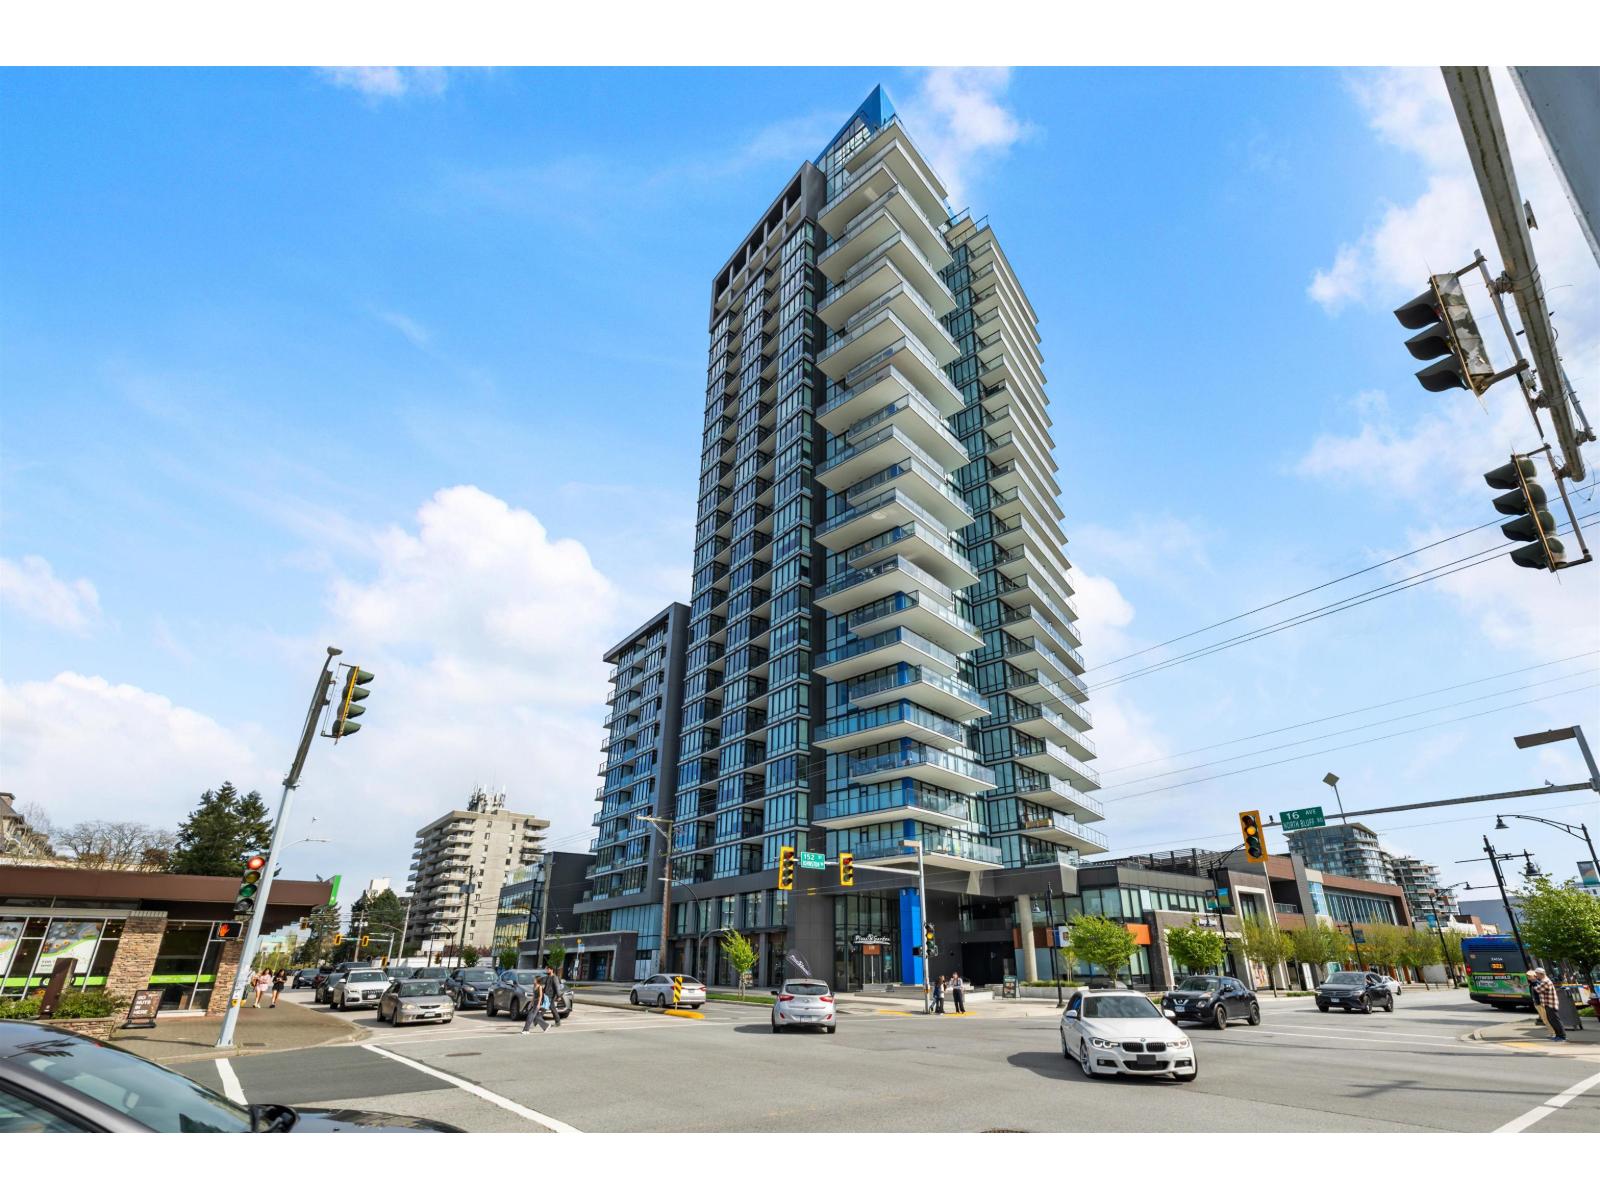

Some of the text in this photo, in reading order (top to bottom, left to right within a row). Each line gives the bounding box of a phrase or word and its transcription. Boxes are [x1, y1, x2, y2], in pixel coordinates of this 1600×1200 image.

[1286, 808, 1317, 820] 16 AVE
[803, 853, 815, 861] 152
